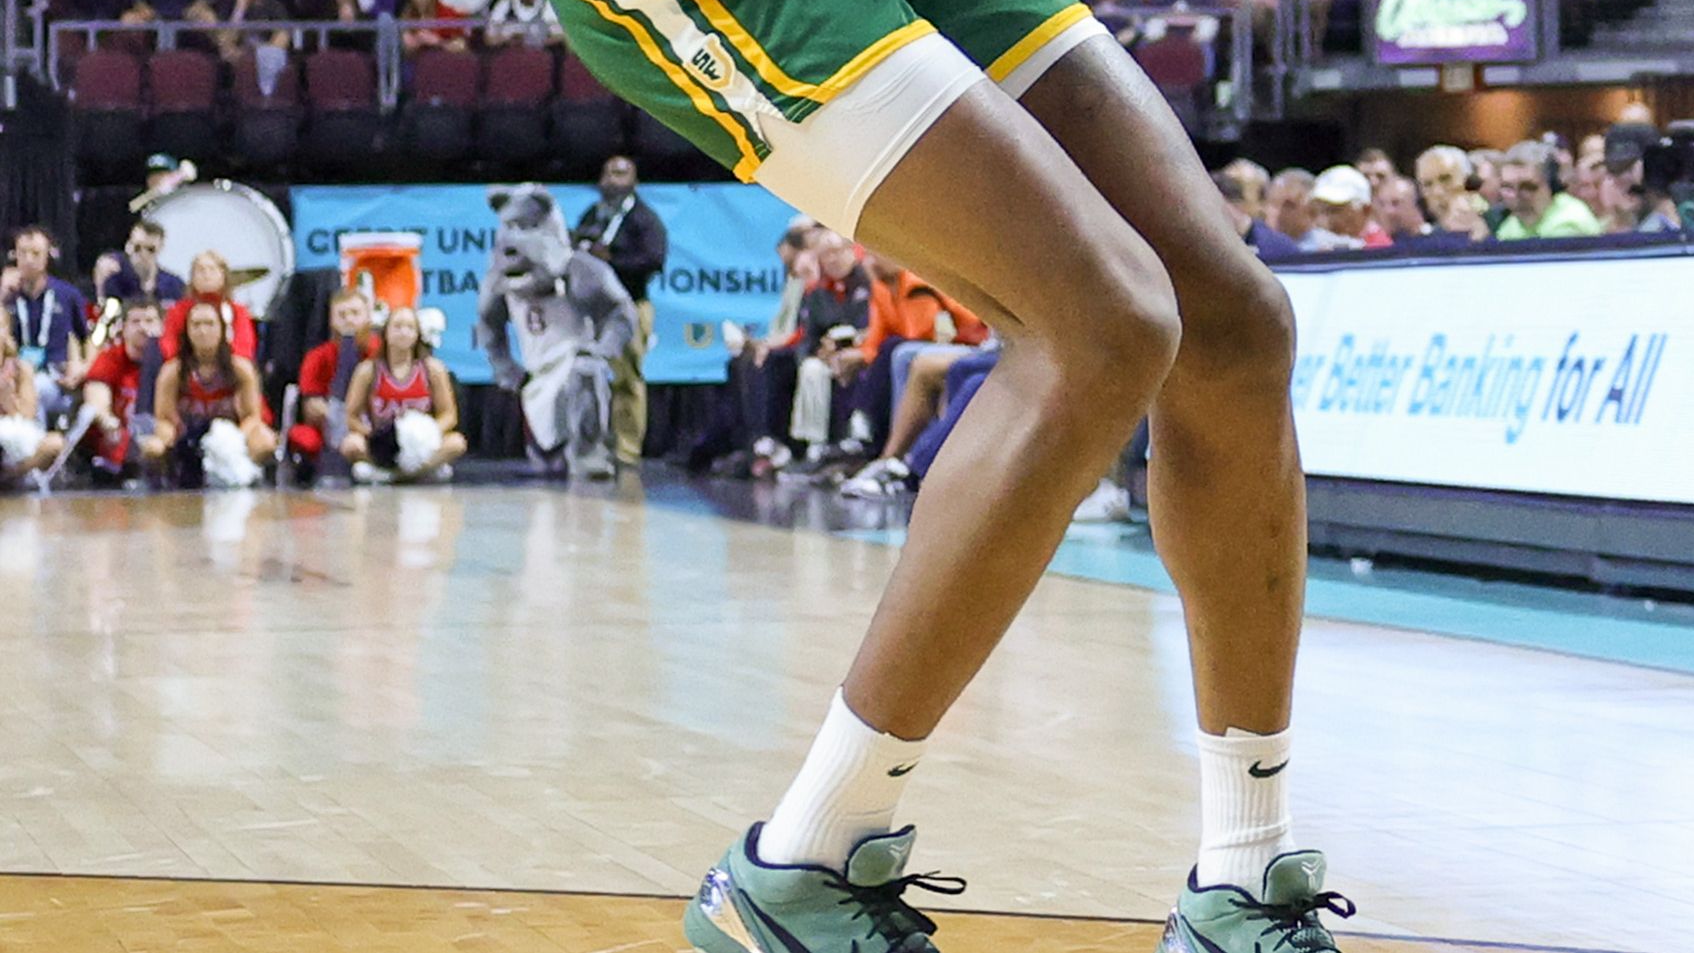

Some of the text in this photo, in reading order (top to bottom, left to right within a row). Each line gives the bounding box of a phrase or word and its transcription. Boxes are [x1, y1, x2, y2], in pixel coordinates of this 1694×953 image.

[1317, 332, 1414, 412] Better
[1408, 332, 1547, 445] Banking
[1541, 330, 1607, 422] for
[1594, 332, 1669, 425] All
